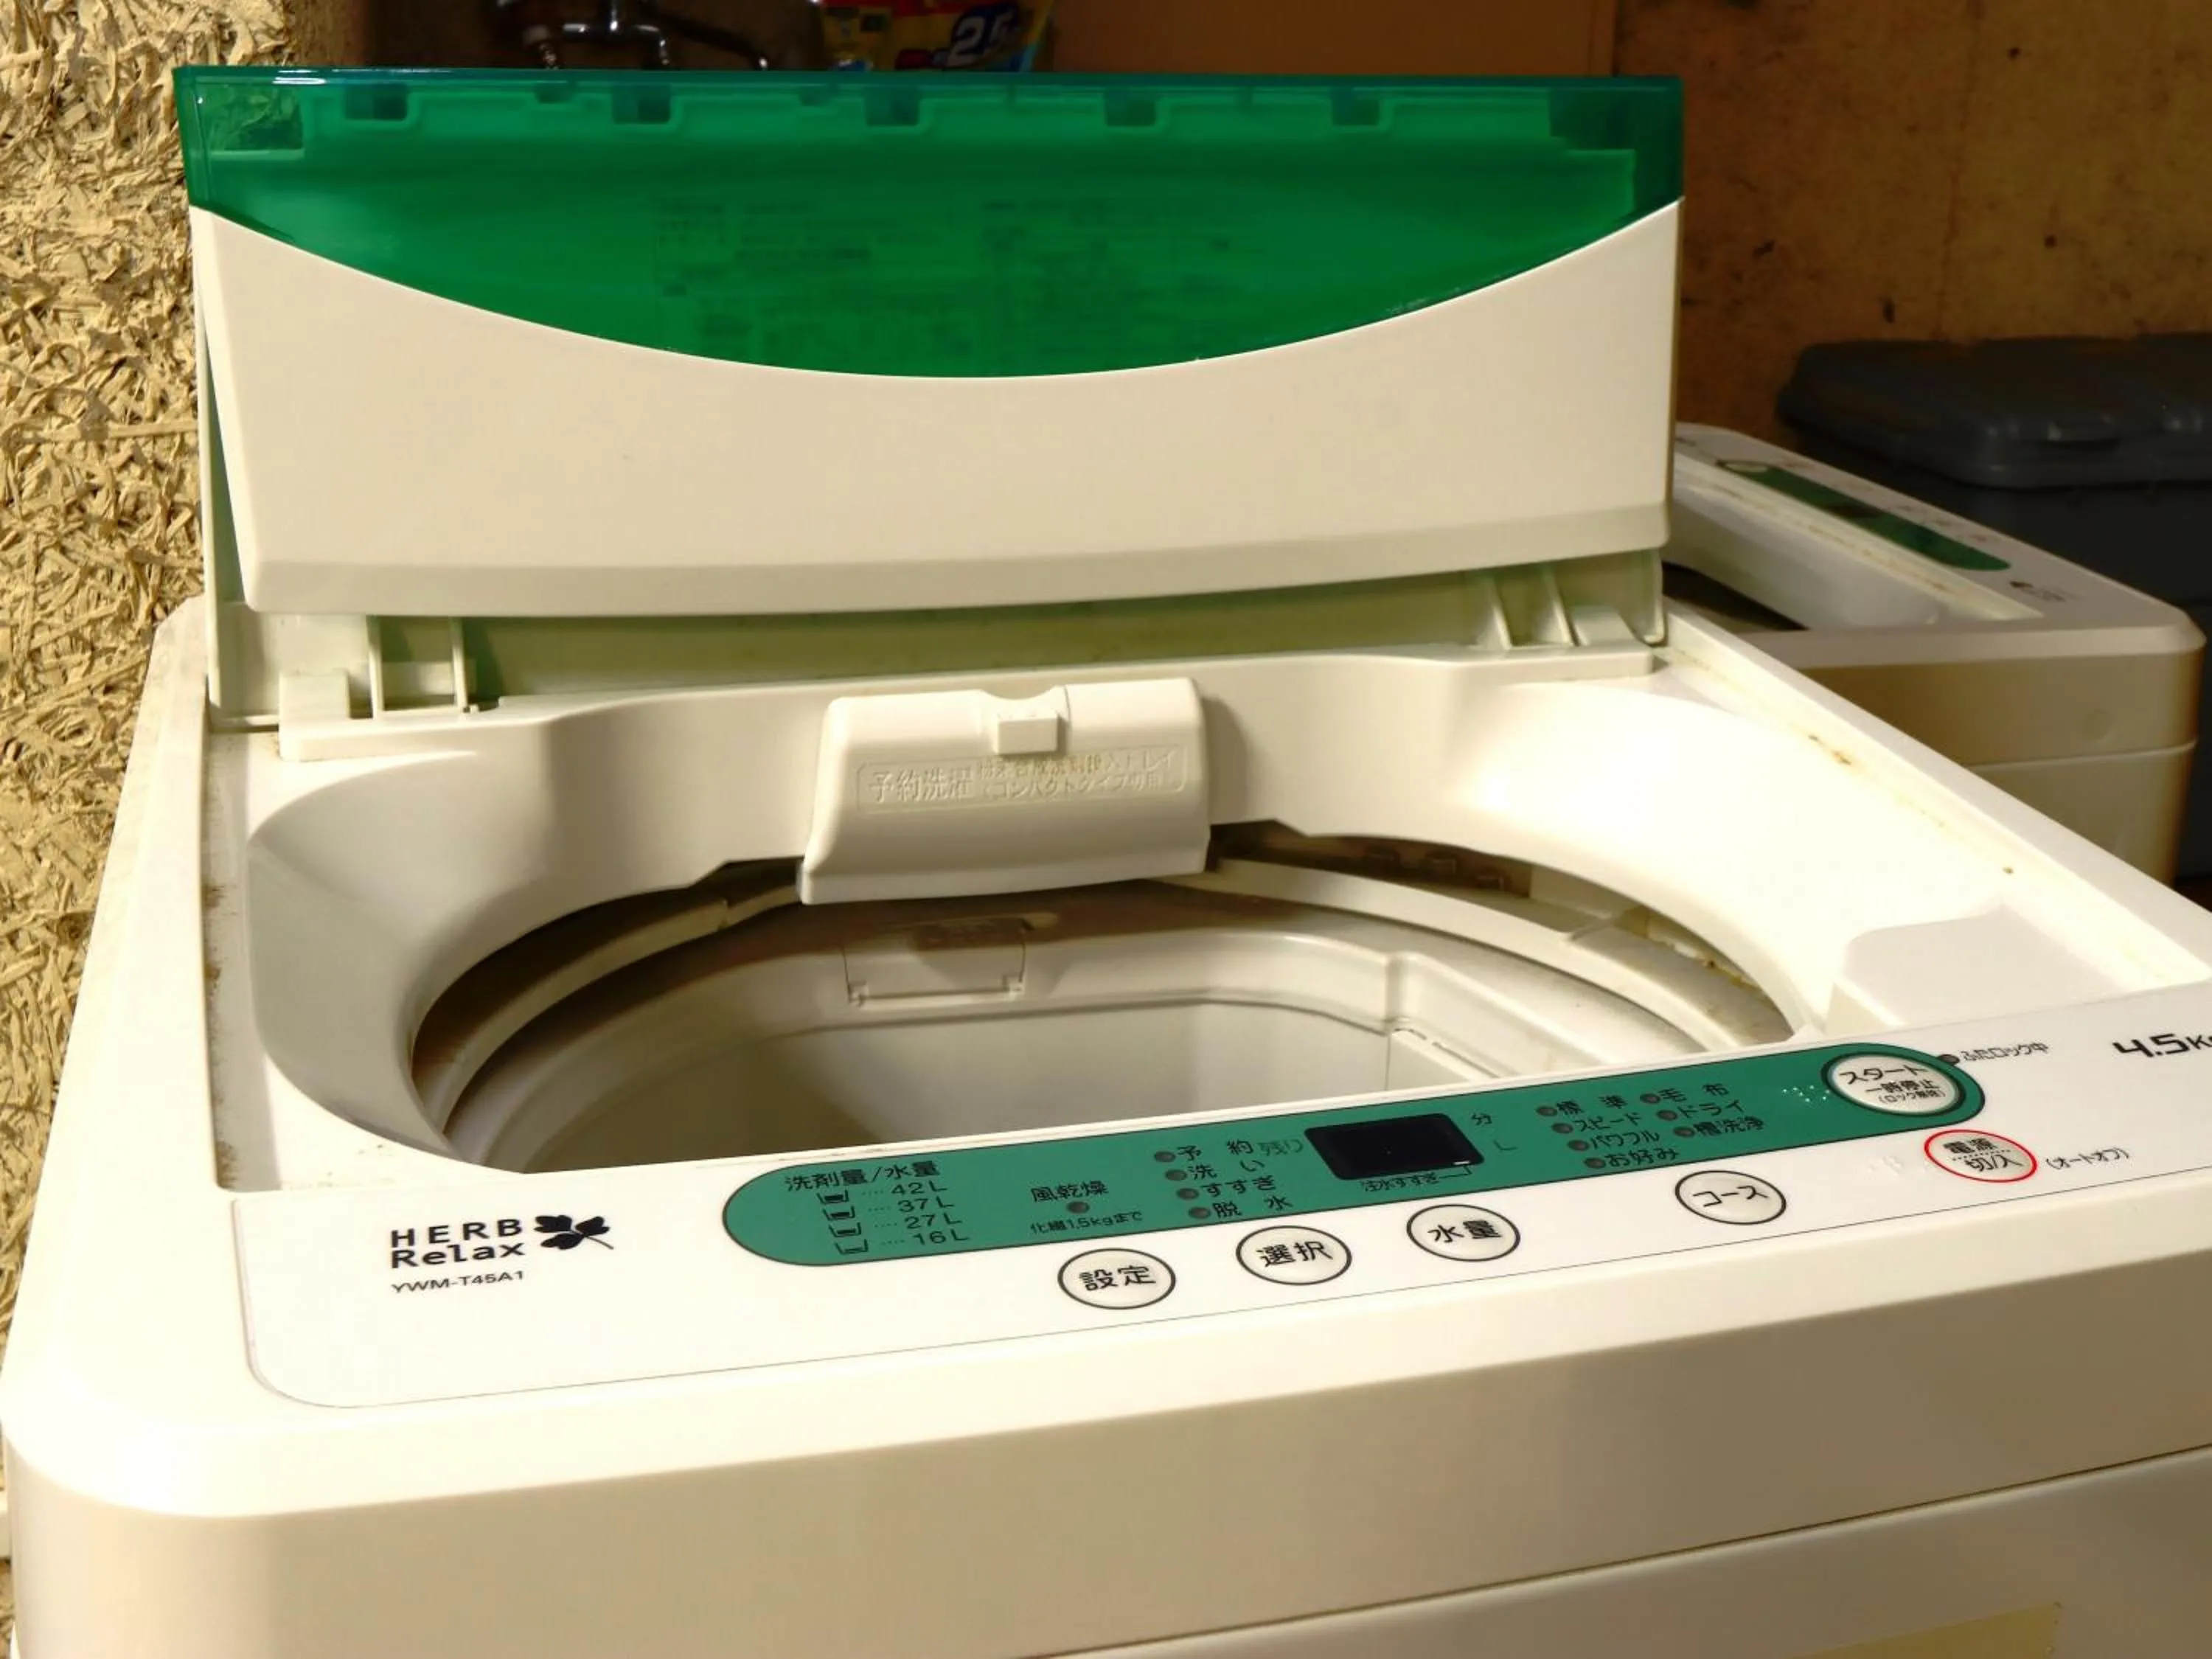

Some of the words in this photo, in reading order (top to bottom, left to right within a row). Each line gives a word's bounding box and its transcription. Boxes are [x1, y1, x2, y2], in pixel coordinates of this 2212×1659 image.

[2112, 1034, 2212, 1059] 4.5K
[1838, 1064, 1930, 1086] スタート
[1677, 1099, 1746, 1120] ドライ
[1604, 1146, 1679, 1167] お好み
[784, 1160, 941, 1192] 洗剤量/水量
[1201, 1175, 1278, 1198] すすぎ
[1692, 1185, 1769, 1207] コース
[391, 1218, 524, 1248] HERB
[1427, 1219, 1504, 1243] 水量
[391, 1242, 526, 1269] Relax
[1256, 1239, 1335, 1268] 選択
[391, 1270, 525, 1293] YWM-T45A1
[1079, 1265, 1158, 1292] 設定
